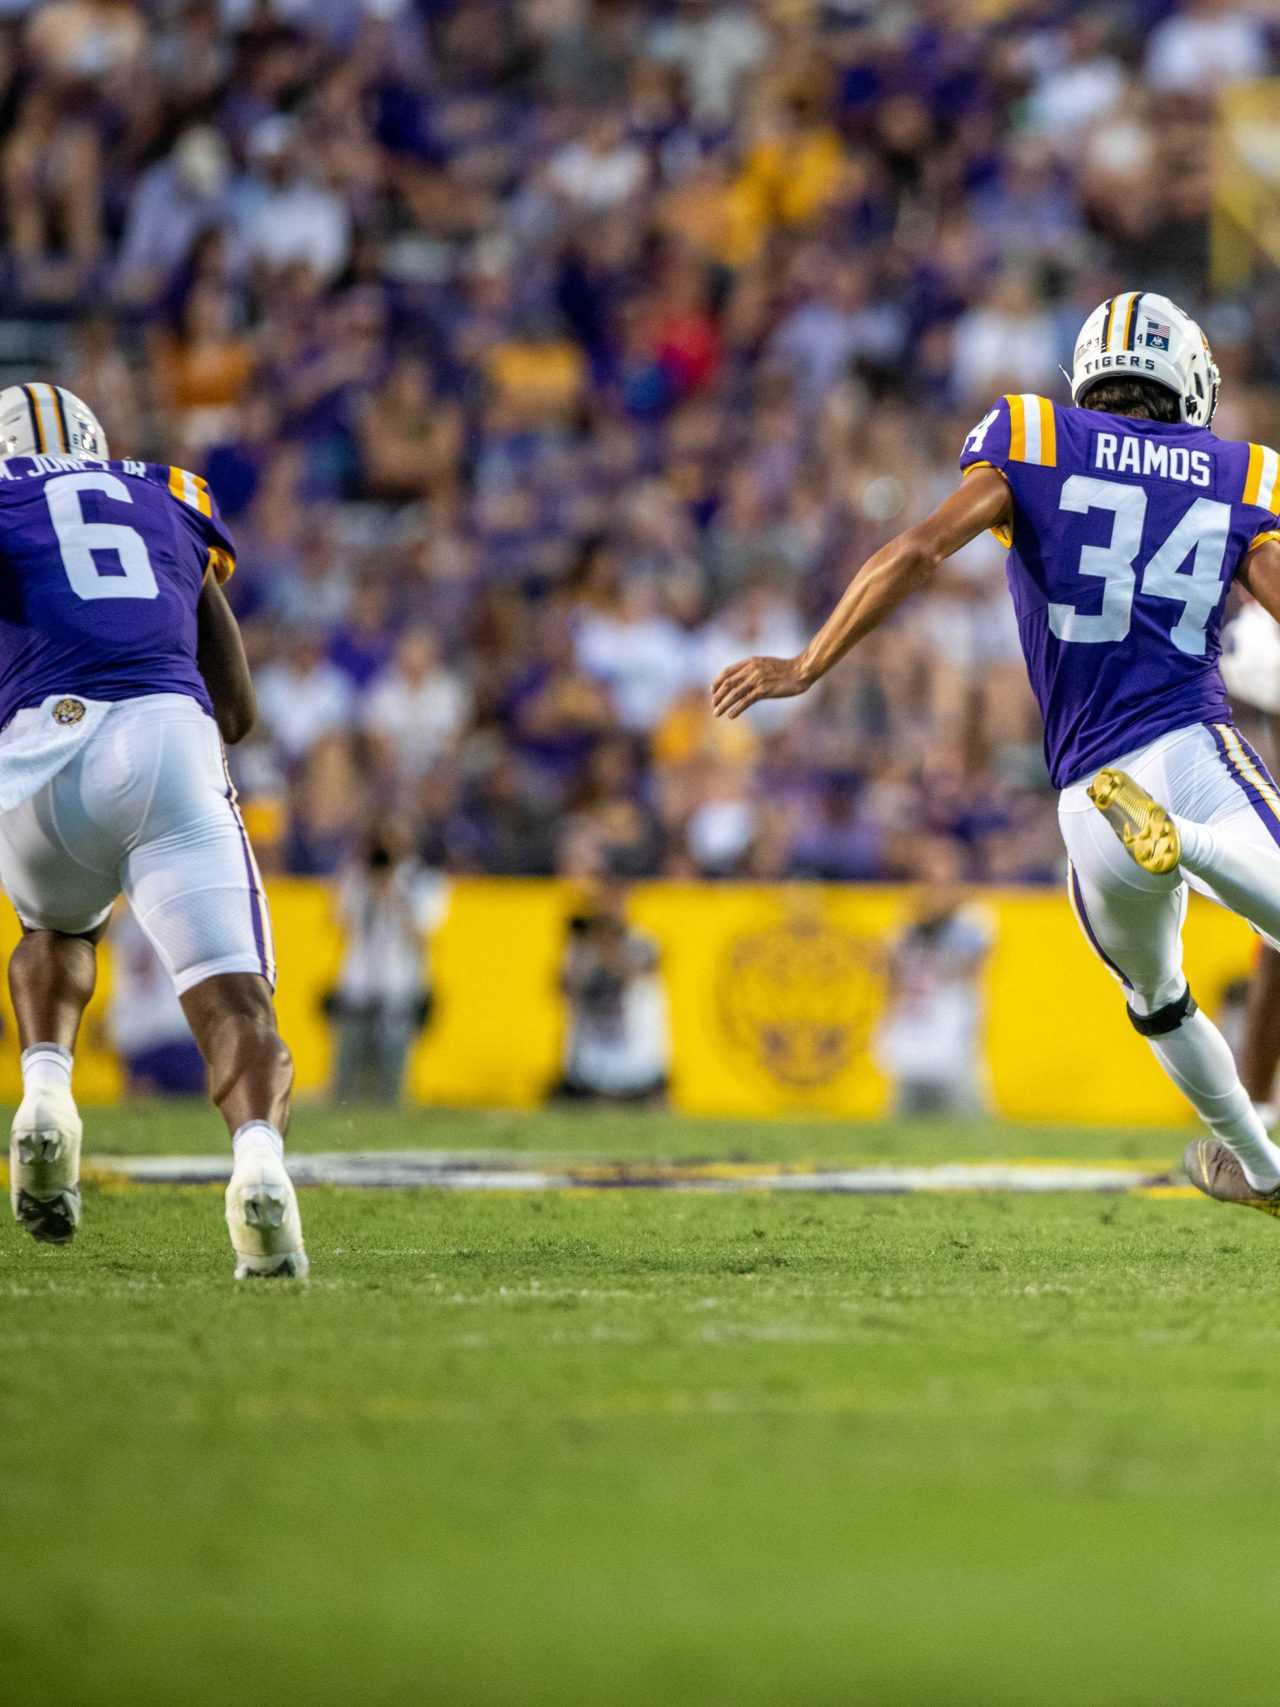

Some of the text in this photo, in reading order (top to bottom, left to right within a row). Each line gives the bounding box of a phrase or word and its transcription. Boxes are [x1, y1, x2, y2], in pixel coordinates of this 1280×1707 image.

[1084, 355, 1155, 374] TIGERS
[1137, 334, 1143, 344] 4
[1095, 432, 1210, 487] RAMOS
[43, 471, 160, 600] 6
[1048, 475, 1232, 656] 34
